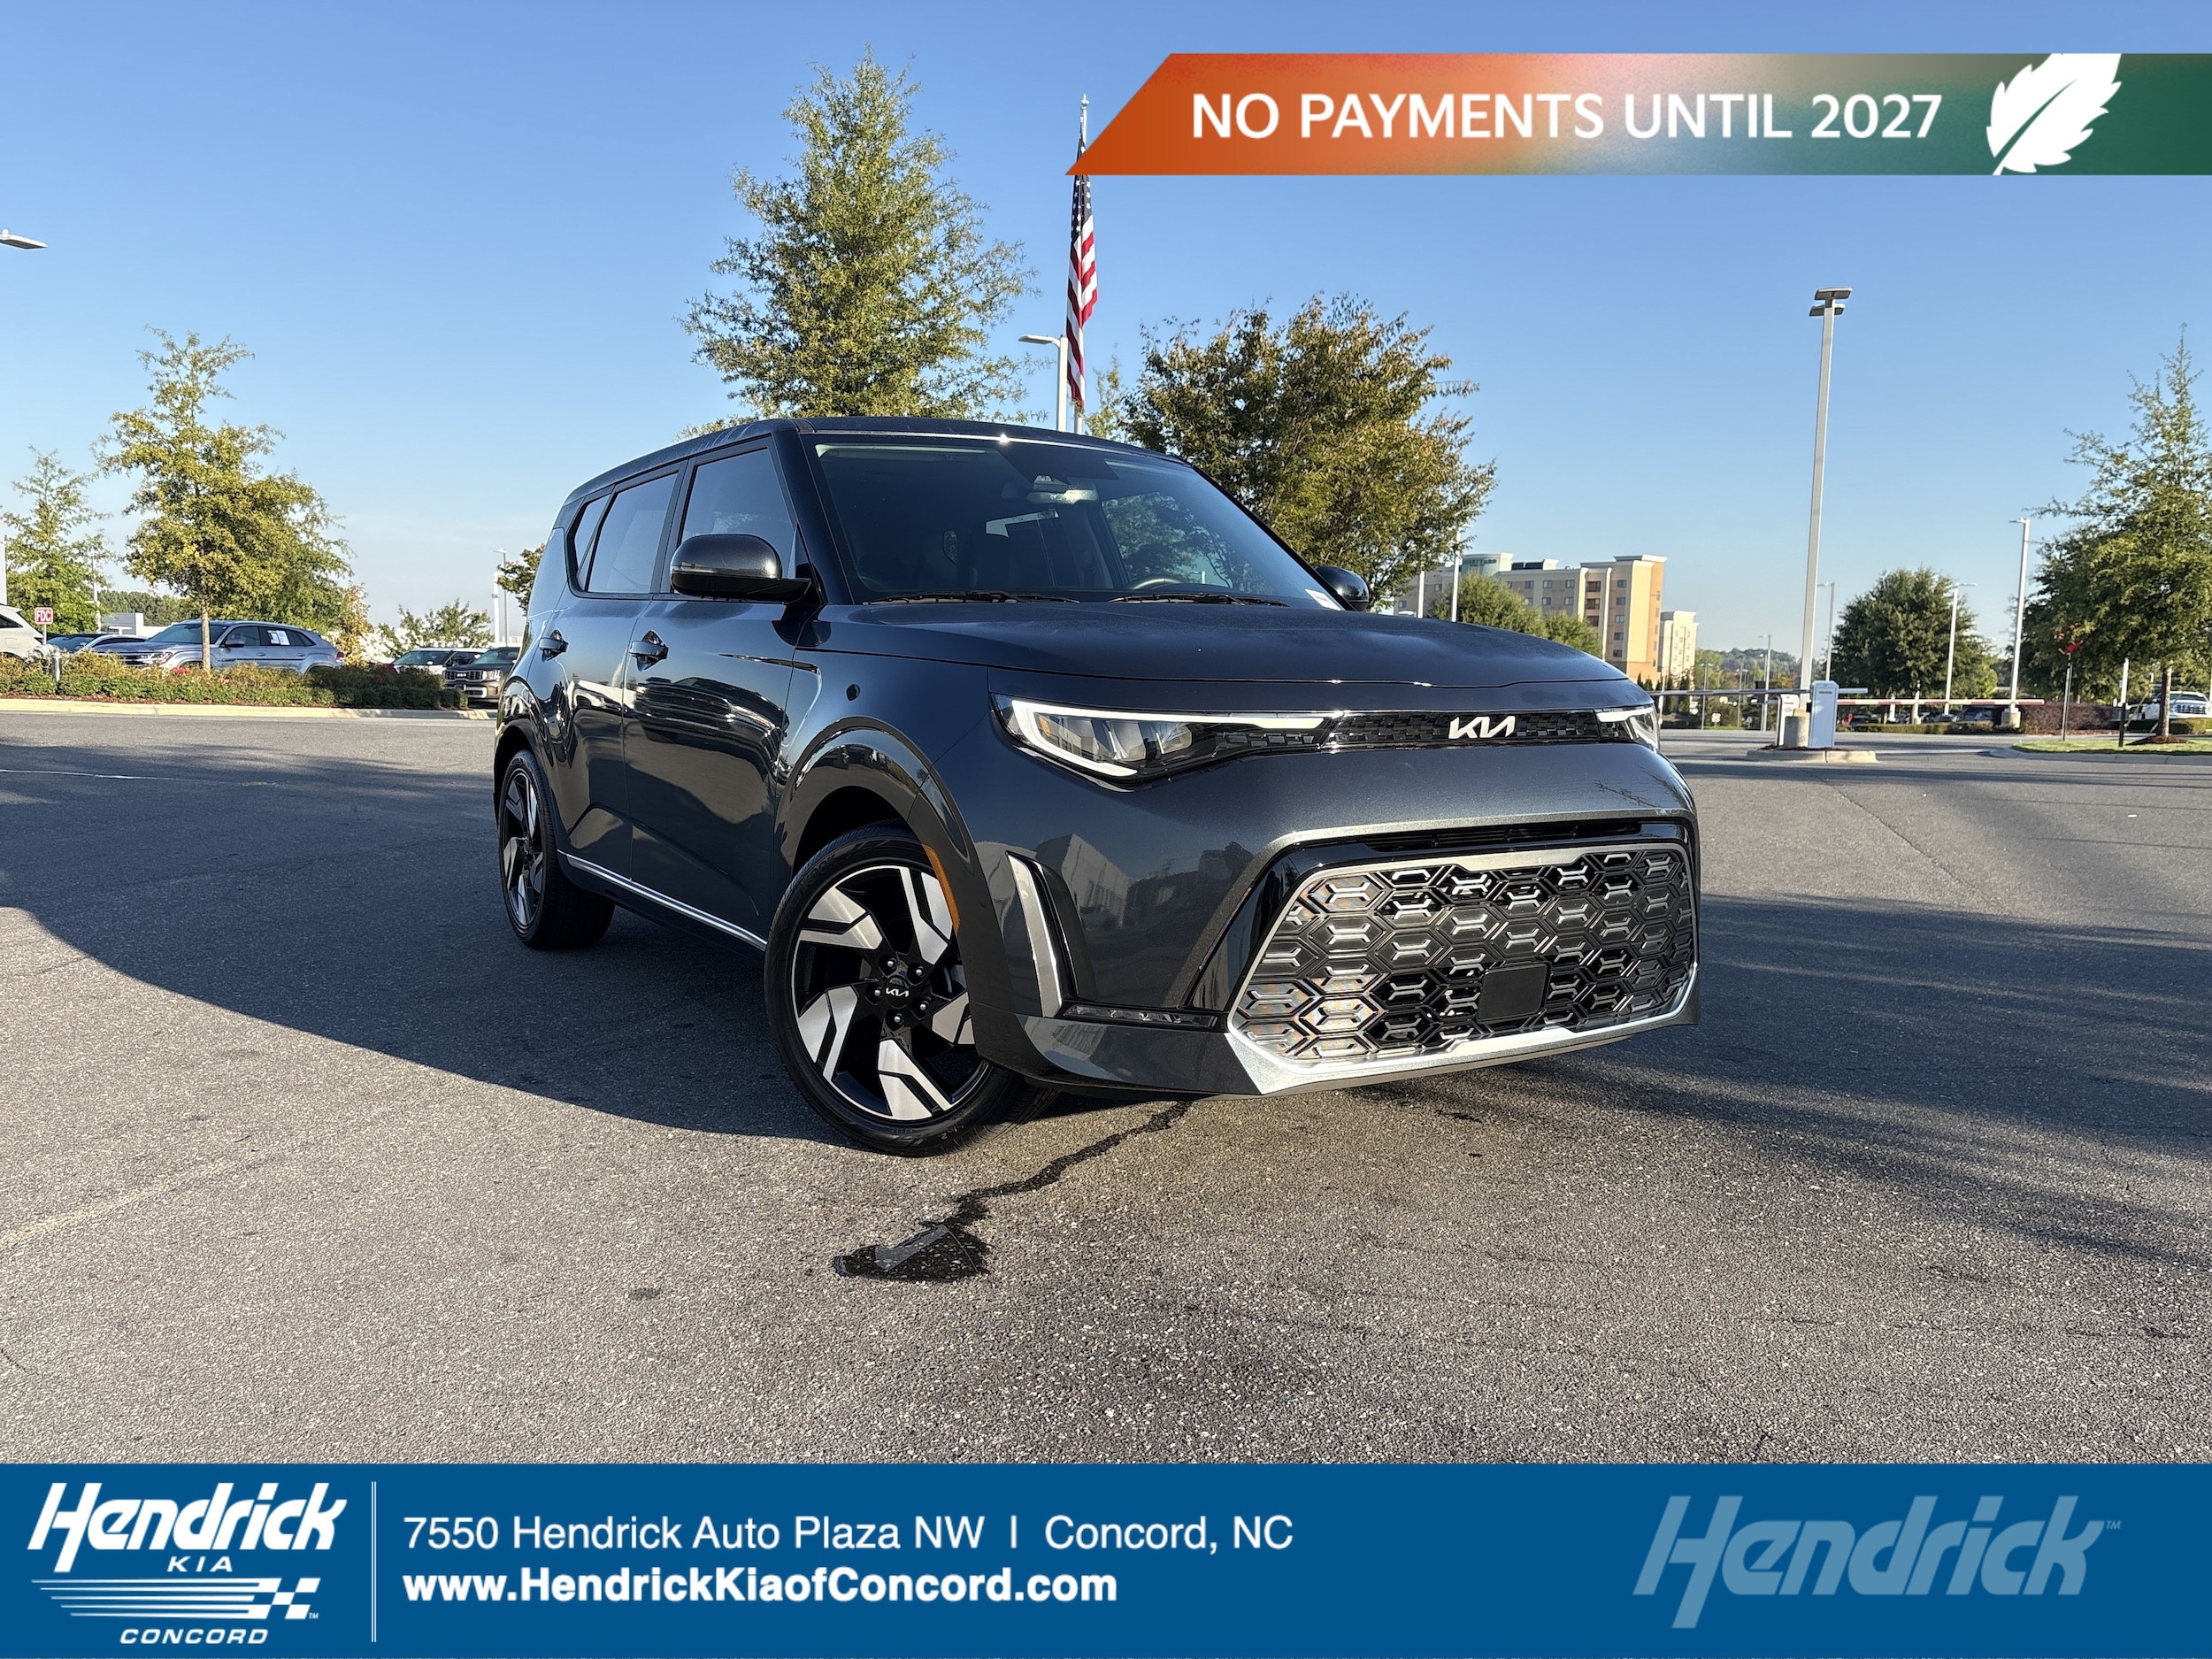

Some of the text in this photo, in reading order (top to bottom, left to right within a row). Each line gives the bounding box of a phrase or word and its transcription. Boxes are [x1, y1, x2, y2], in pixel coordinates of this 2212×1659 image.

[36, 610, 51, 622] FDC
[1448, 715, 1516, 739] KIA
[885, 987, 910, 998] KIA
